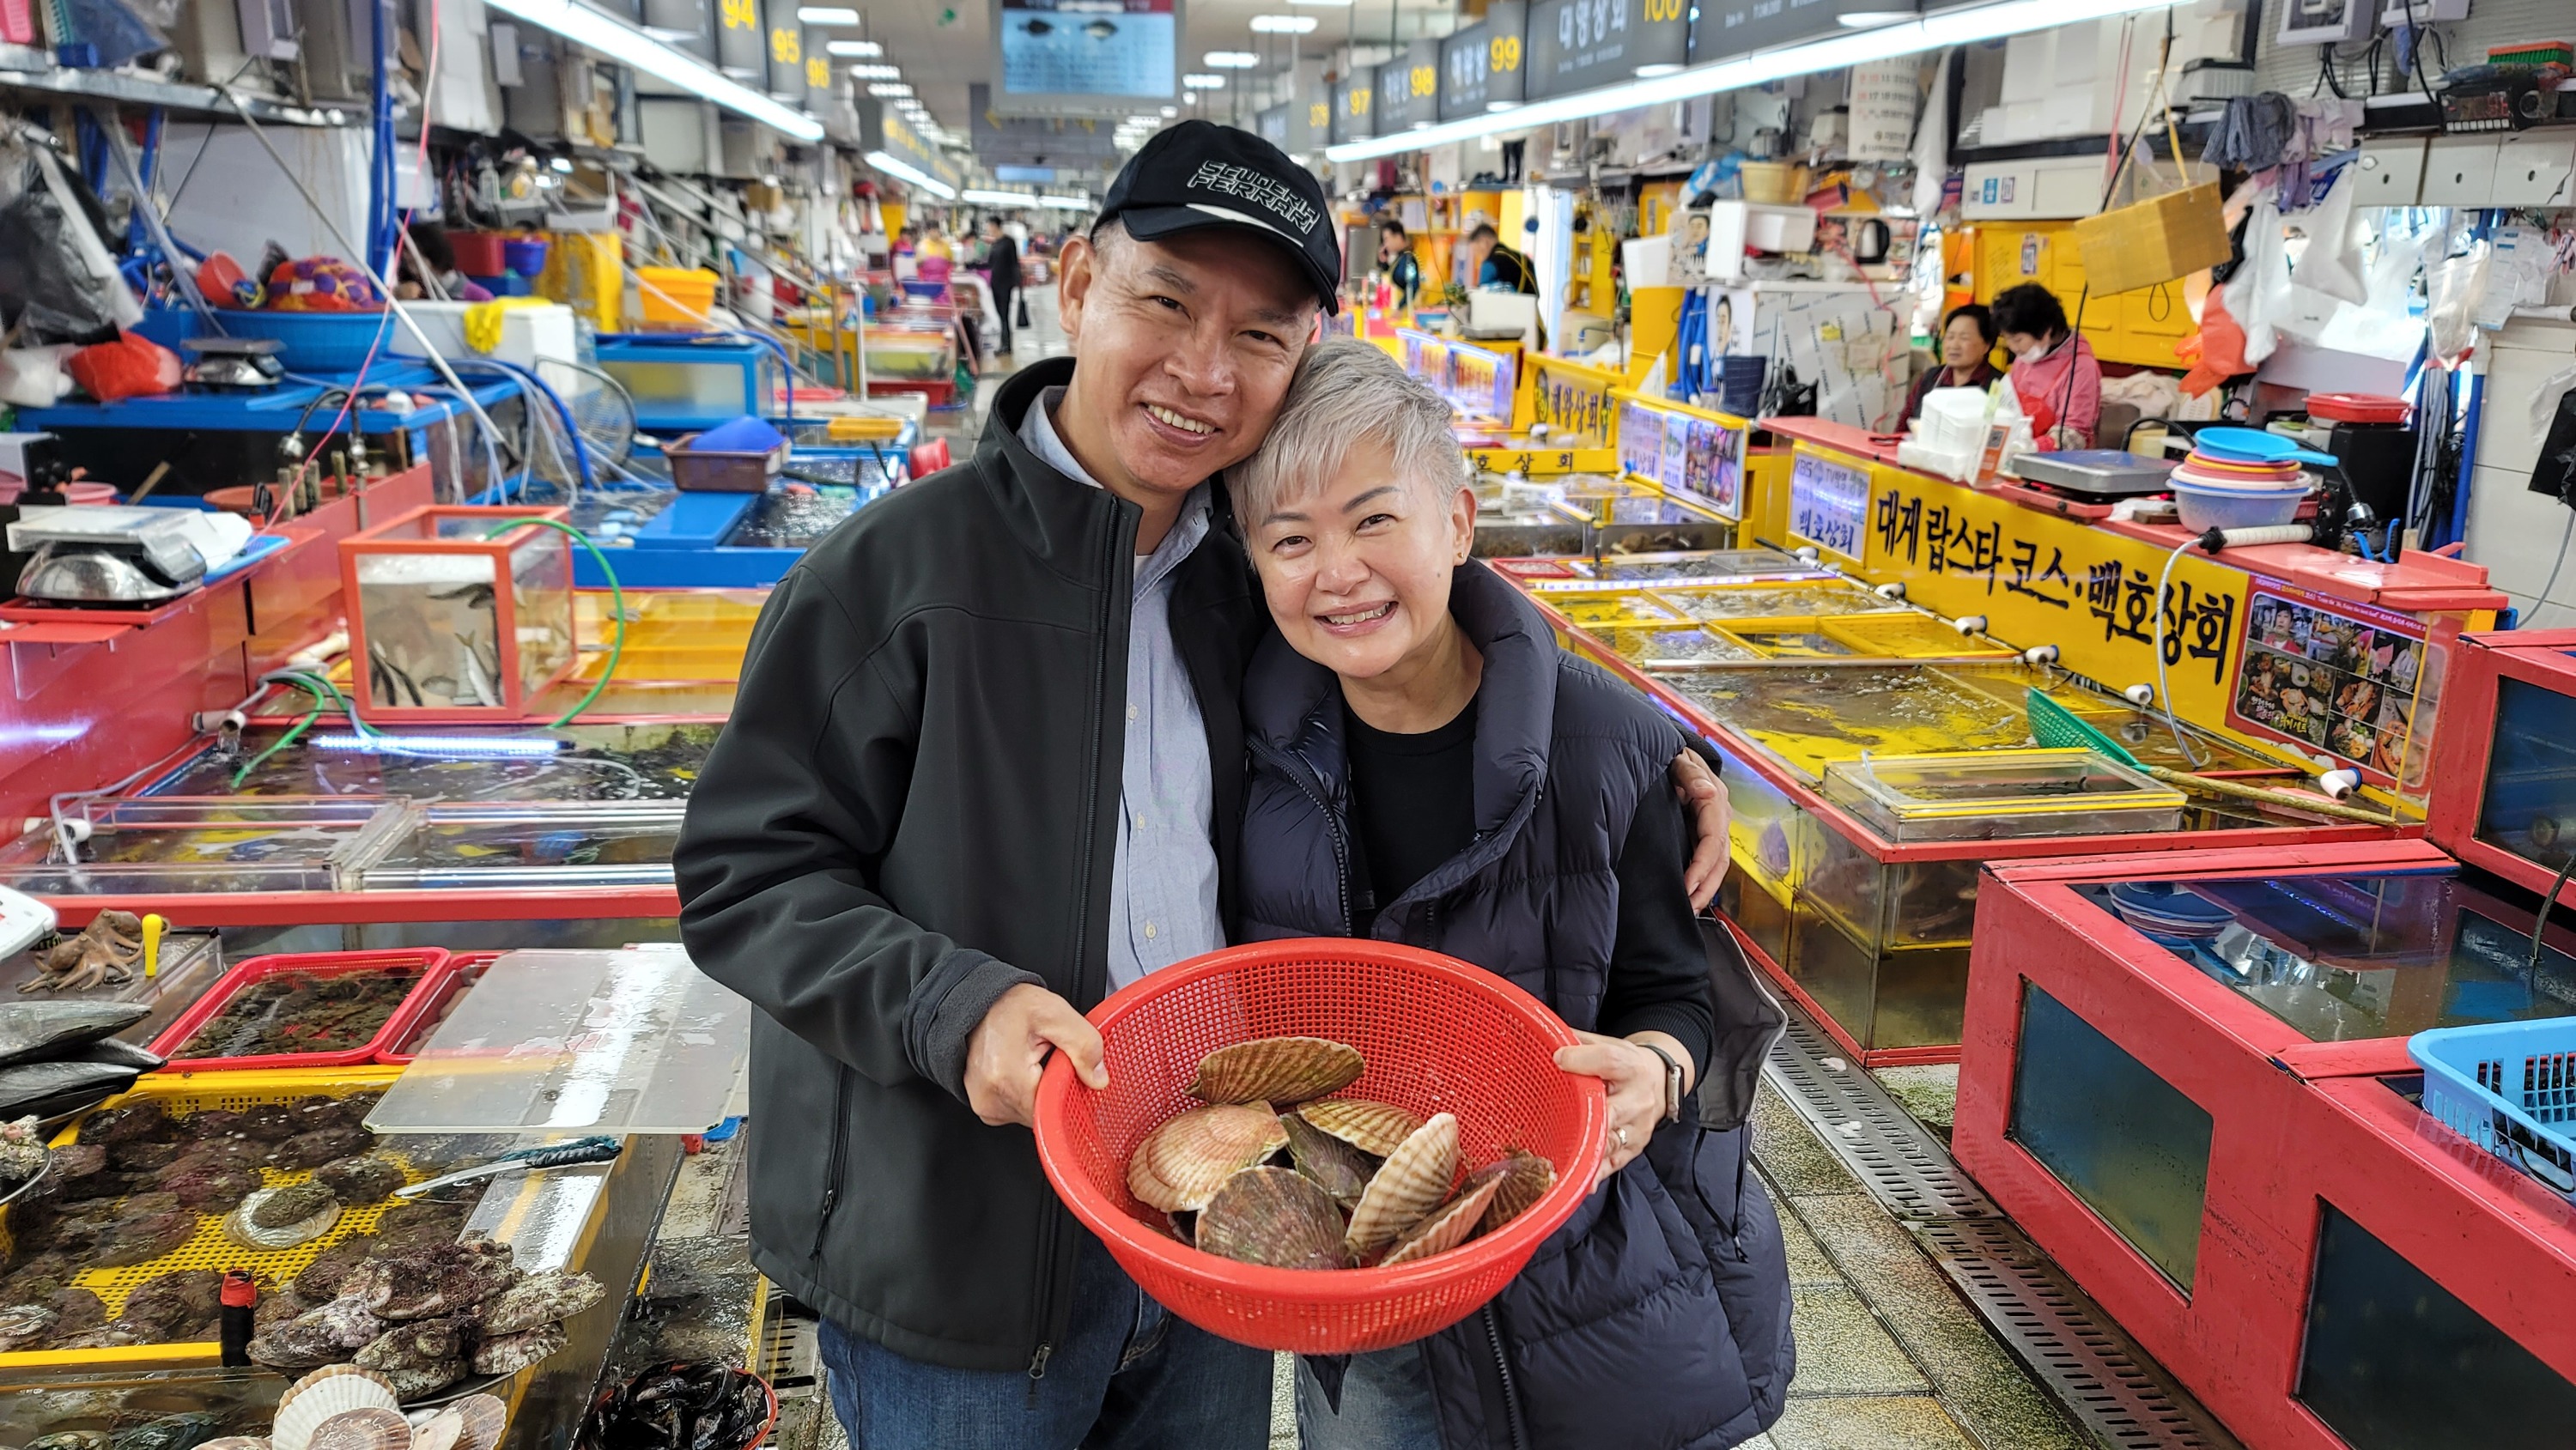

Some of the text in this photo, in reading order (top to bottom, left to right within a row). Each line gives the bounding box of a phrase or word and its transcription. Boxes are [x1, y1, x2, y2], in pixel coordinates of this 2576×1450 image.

[721, 0, 756, 31] 94
[772, 27, 800, 64] 95
[1490, 35, 1521, 72] 99
[1410, 65, 1436, 97] 98
[1350, 88, 1371, 116] 97
[1187, 172, 1313, 234] FERRARI
[1799, 509, 1854, 555] 백호상회
[1876, 489, 1923, 567] 대게
[1926, 505, 2003, 596] 랍스타
